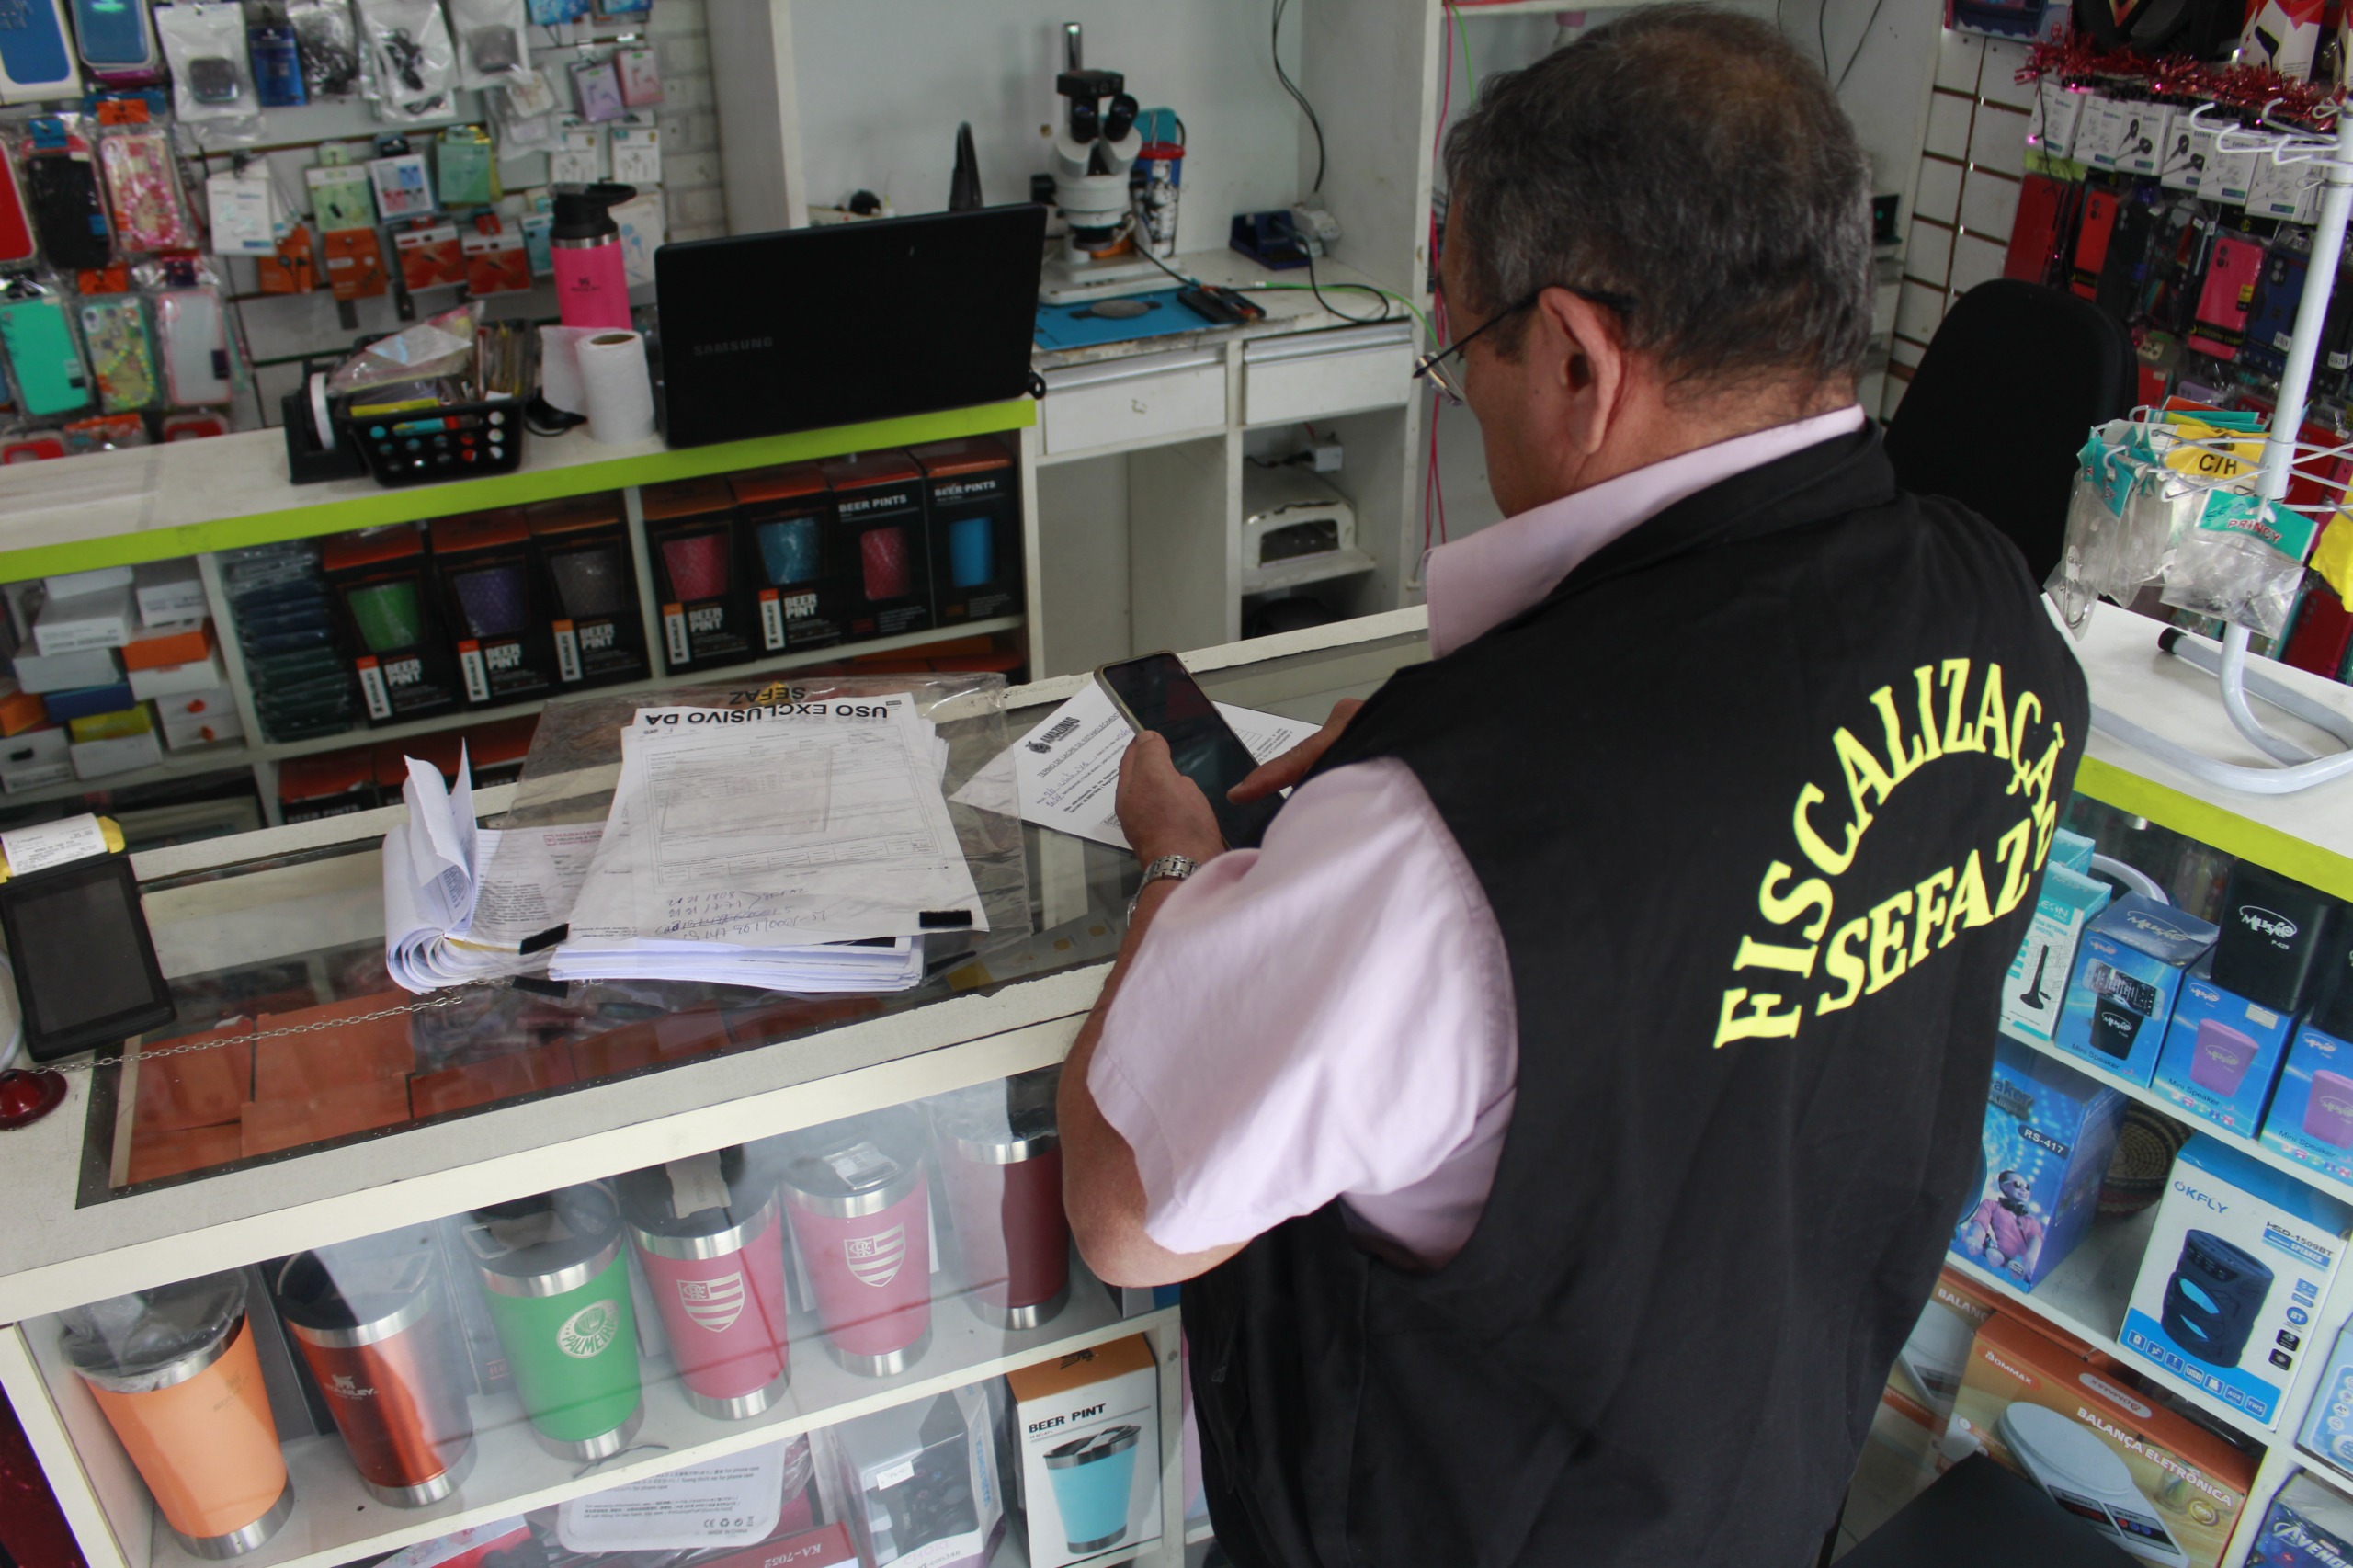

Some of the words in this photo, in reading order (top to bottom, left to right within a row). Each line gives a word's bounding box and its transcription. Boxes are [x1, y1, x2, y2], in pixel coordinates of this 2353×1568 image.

[693, 336, 774, 356] SAMSUNG
[2199, 454, 2237, 474] C/H
[934, 484, 963, 497] BEER
[964, 480, 996, 493] PINTS
[838, 500, 870, 513] BEER
[872, 494, 907, 508] PINTS
[2227, 518, 2281, 543] PRINCY
[784, 593, 817, 608] BEER
[689, 608, 722, 622] BEER
[786, 604, 816, 619] PINT
[579, 624, 614, 640] BEER
[690, 618, 722, 633] PINT
[581, 634, 614, 650] PINT
[485, 643, 521, 660] BEER
[384, 659, 421, 676] BEER
[488, 654, 521, 671] PINT
[388, 670, 421, 687] PINT
[729, 687, 805, 705] SEFAZ
[645, 713, 678, 725] DA
[688, 703, 828, 724] EXCLUSIVO
[835, 704, 888, 719] USO
[1040, 716, 1080, 744] AMAZONAS
[288, 812, 320, 824] BEER
[323, 805, 360, 821] PINTS
[1815, 818, 2031, 1017] SEFAZ
[2046, 922, 2068, 936] INTERNA
[2071, 1043, 2087, 1055] Mini
[2088, 1049, 2120, 1070] Speaker
[2168, 1078, 2185, 1091] Mini
[2186, 1085, 2220, 1106] Speaker
[2024, 1128, 2064, 1153] RS-417
[2279, 1130, 2297, 1142] Mini
[2298, 1138, 2336, 1158] Speaker
[2175, 1178, 2228, 1214] OKFLY
[1938, 1289, 1989, 1324] BALANÇ
[2290, 1311, 2304, 1322] BT
[2186, 1367, 2202, 1381] USB
[2227, 1390, 2242, 1401] AUX
[2247, 1401, 2264, 1413] TWS
[1029, 1415, 1065, 1434] BEER
[1071, 1403, 1106, 1421] PINT
[2077, 1406, 2144, 1455] BALANÇA
[2144, 1449, 2234, 1507] ELETRÔNICA
[764, 1543, 823, 1568] KA-7052
